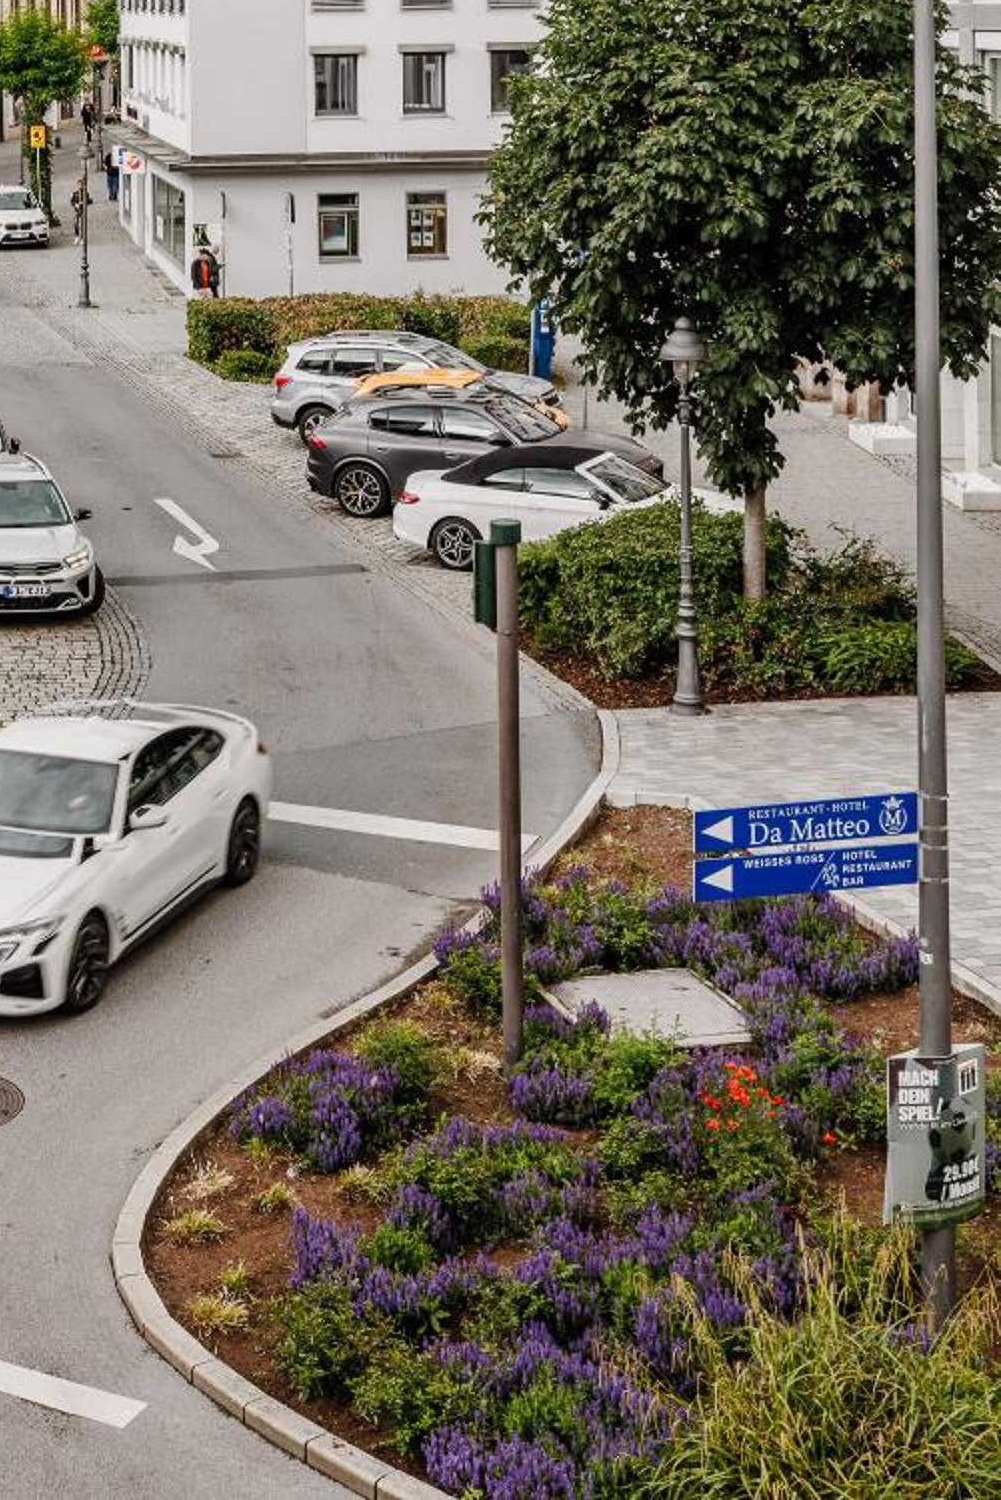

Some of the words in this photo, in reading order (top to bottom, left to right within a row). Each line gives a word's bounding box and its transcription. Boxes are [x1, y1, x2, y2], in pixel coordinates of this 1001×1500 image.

[748, 806, 824, 819] RESTAURANT
[832, 801, 869, 812] HOTEL
[750, 822, 782, 845] Da
[790, 818, 870, 841] Matteo
[743, 855, 792, 869] WEISSES
[842, 850, 877, 861] HOTEL
[842, 860, 913, 873] RESTAURANT
[842, 877, 865, 886] BAR
[898, 1069, 940, 1087] MACH
[898, 1088, 930, 1104] DEIN
[898, 1097, 944, 1122] SPIEL!
